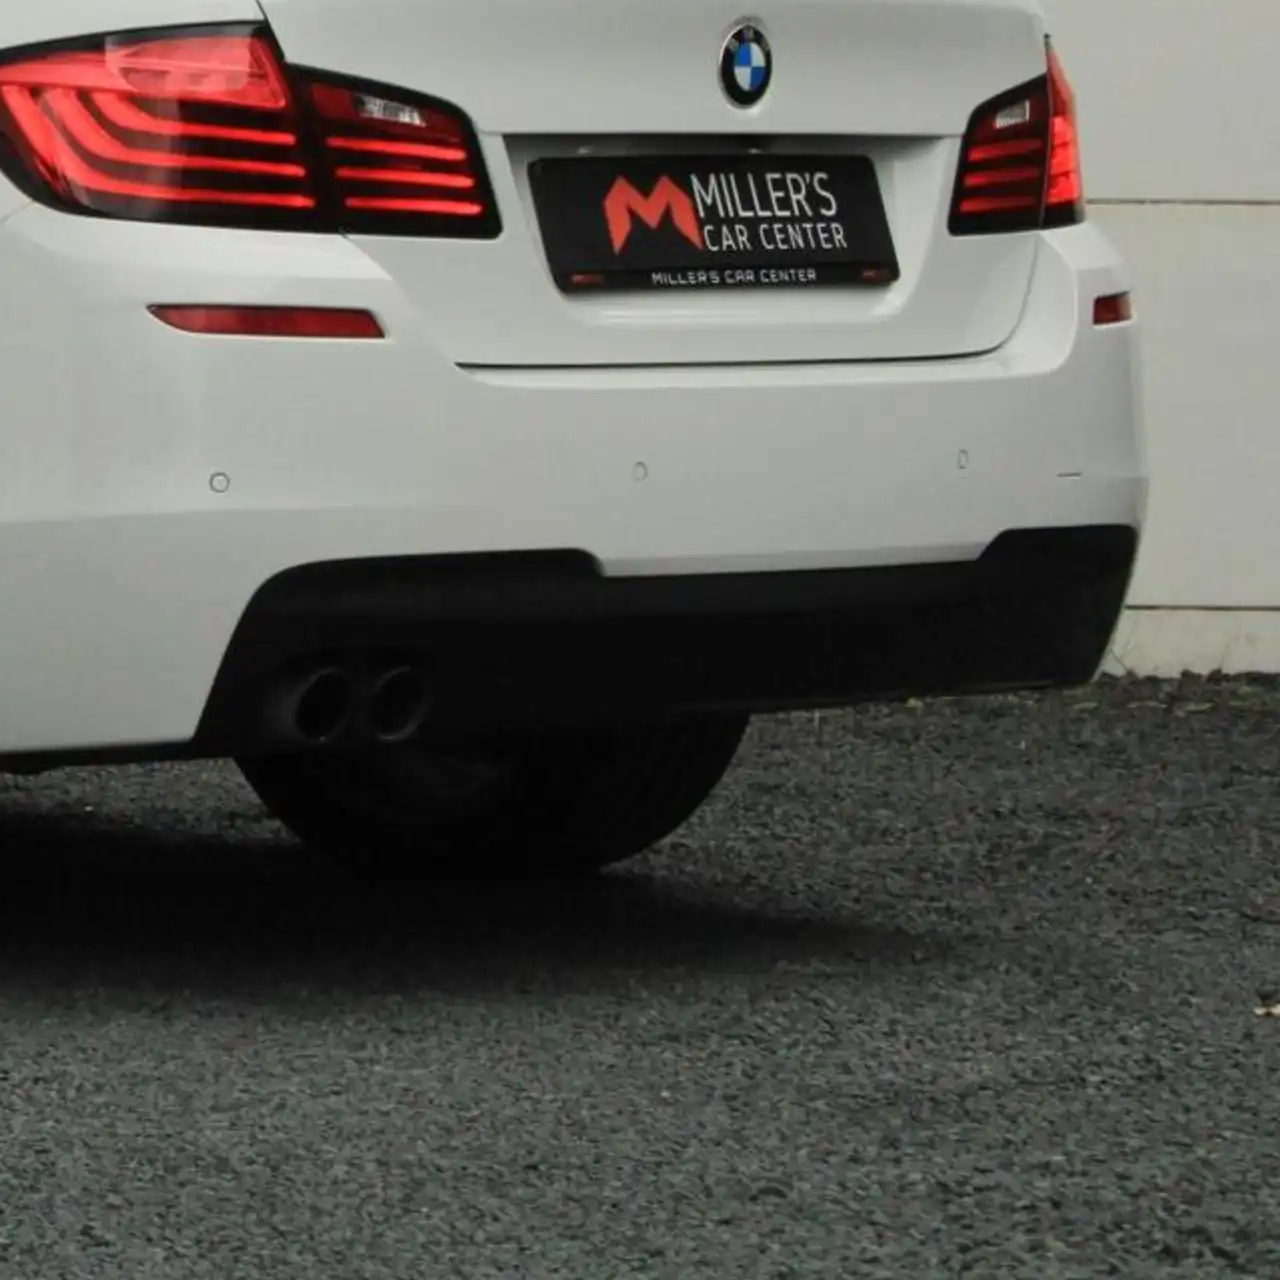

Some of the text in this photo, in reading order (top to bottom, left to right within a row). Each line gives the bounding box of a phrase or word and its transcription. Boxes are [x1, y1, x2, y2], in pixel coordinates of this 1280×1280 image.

[690, 171, 839, 220] MILLER'S
[702, 221, 849, 253] CAR CENTER
[723, 269, 756, 284] CAR
[759, 267, 818, 284] CENTER
